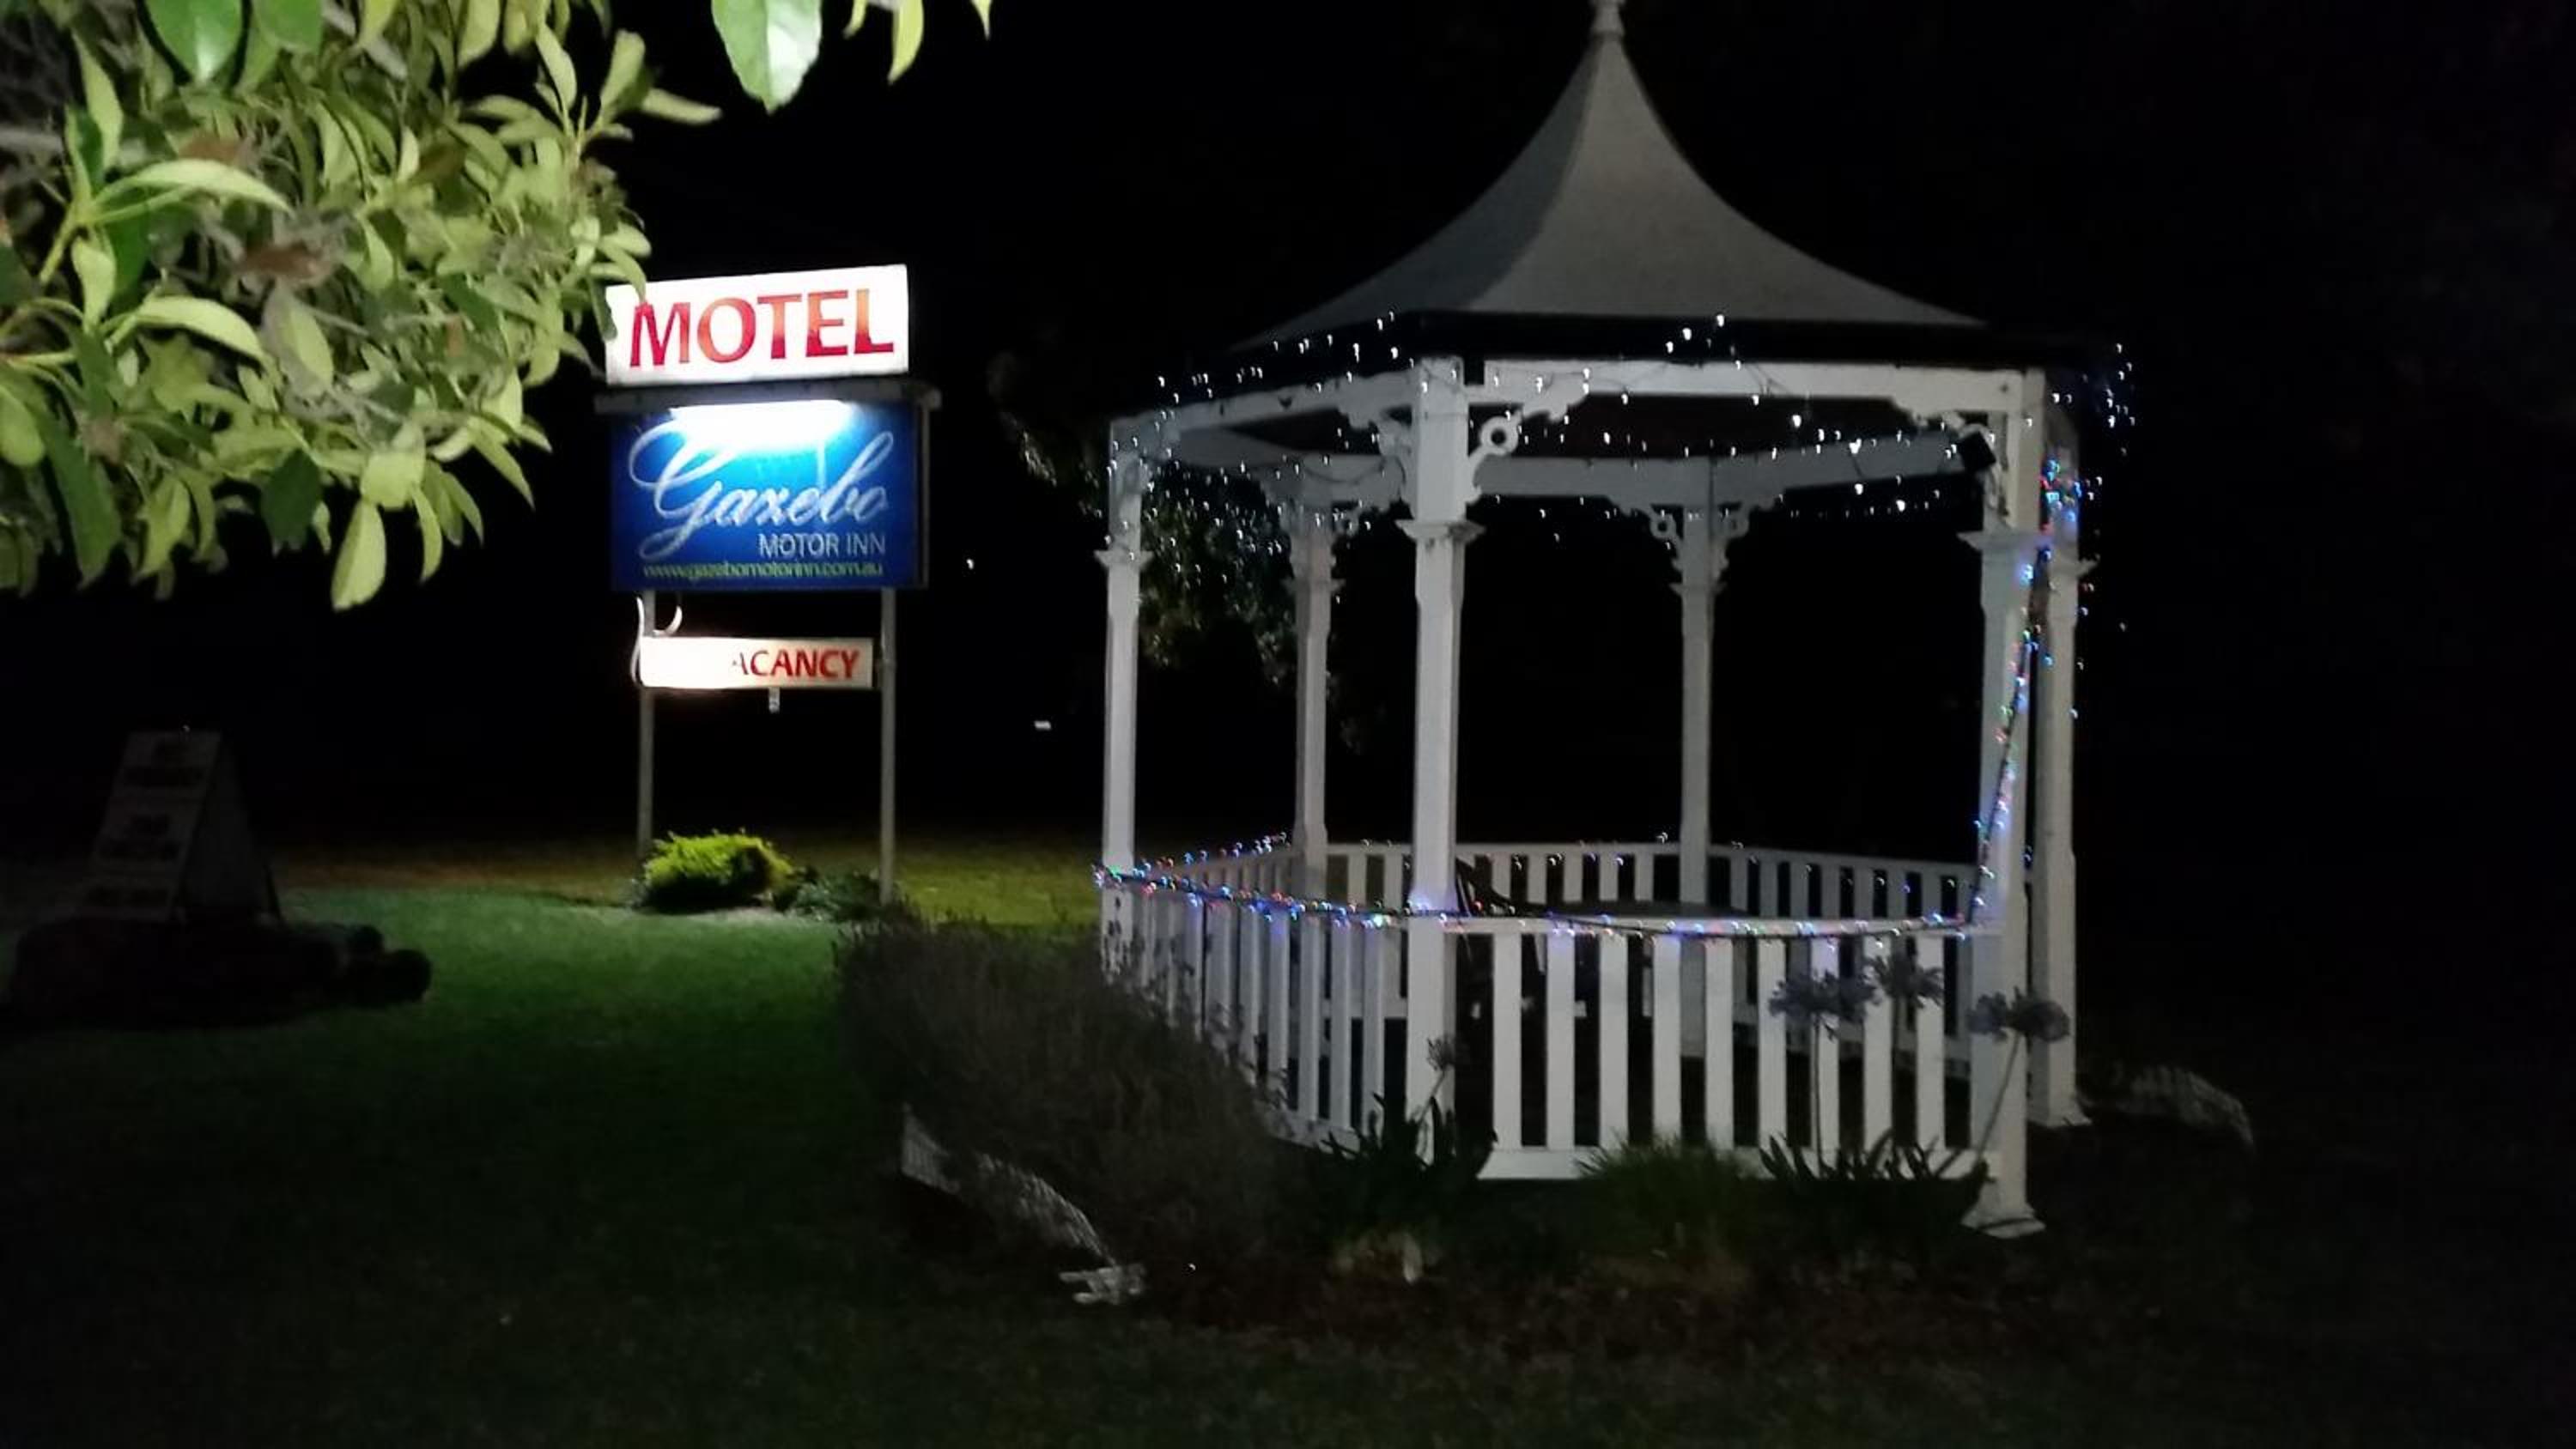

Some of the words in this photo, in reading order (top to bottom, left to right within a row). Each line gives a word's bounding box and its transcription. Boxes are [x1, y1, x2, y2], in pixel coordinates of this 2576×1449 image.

[629, 288, 894, 367] MOTEL
[629, 415, 894, 561] Gazebo
[759, 533, 839, 557] MOTOR
[845, 532, 886, 555] INN
